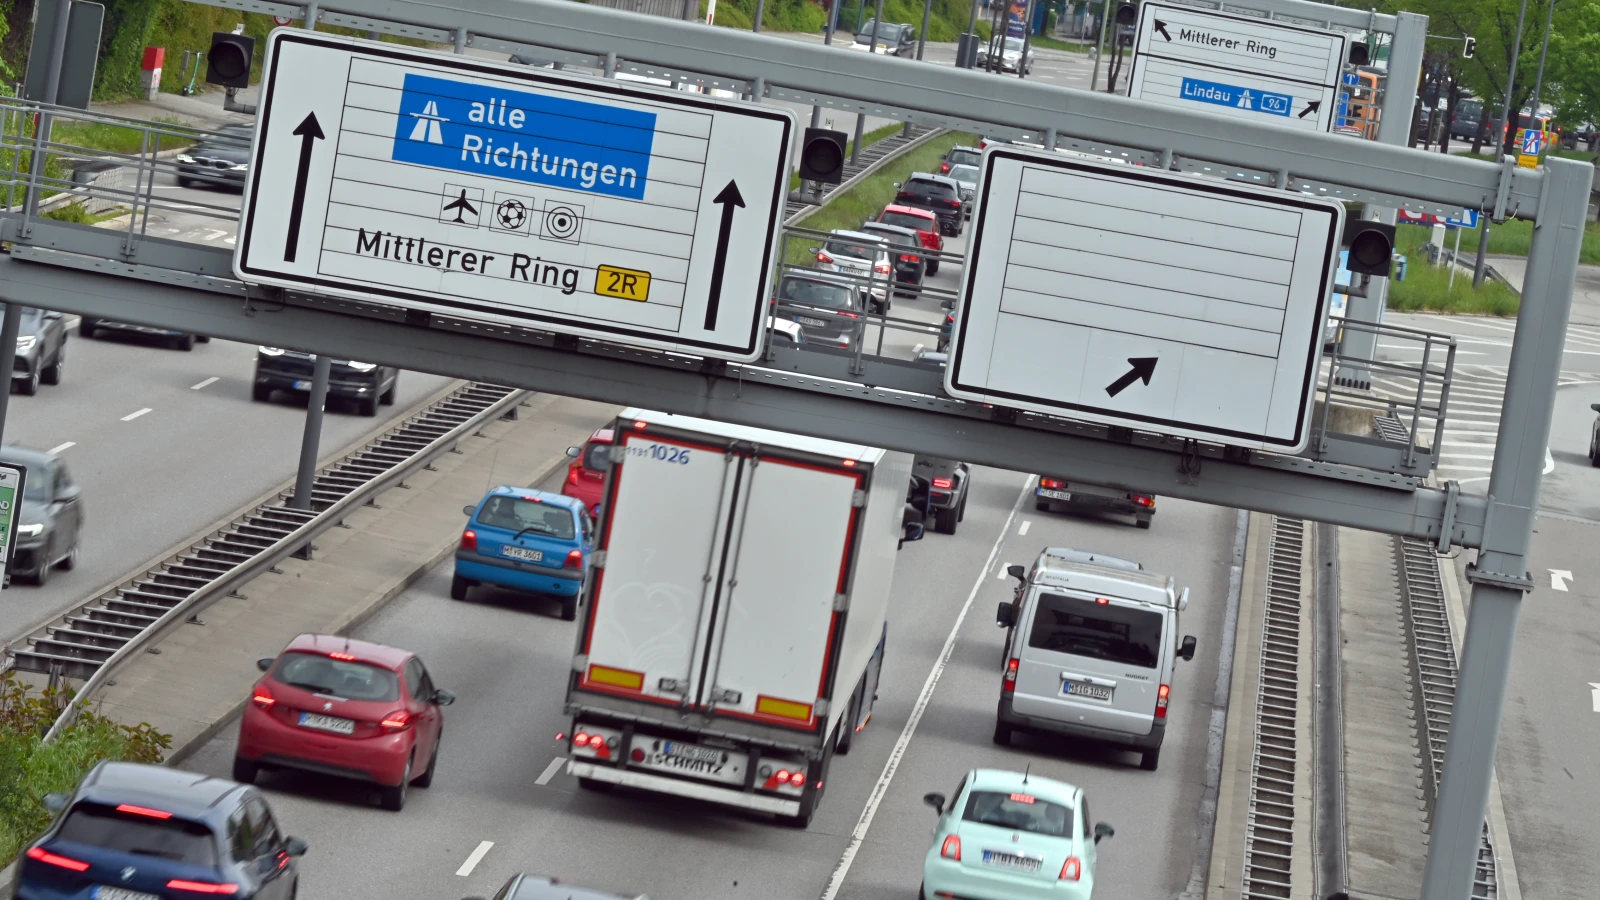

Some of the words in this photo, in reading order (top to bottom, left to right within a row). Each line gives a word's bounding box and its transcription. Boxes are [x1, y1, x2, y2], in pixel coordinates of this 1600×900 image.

[1179, 28, 1240, 50] Mittlerer
[1246, 40, 1277, 59] Ring
[1184, 82, 1231, 102] Lindau
[1268, 98, 1280, 109] 96
[467, 97, 526, 129] alle
[461, 133, 637, 189] Richtungen
[355, 227, 495, 274] Mittlerer
[509, 252, 579, 295] Ring
[606, 271, 638, 295] 2R
[649, 443, 691, 465] 1026
[1125, 672, 1149, 681] NUGGET
[1089, 686, 1109, 698] 1032
[654, 753, 725, 774] SCHMITZ
